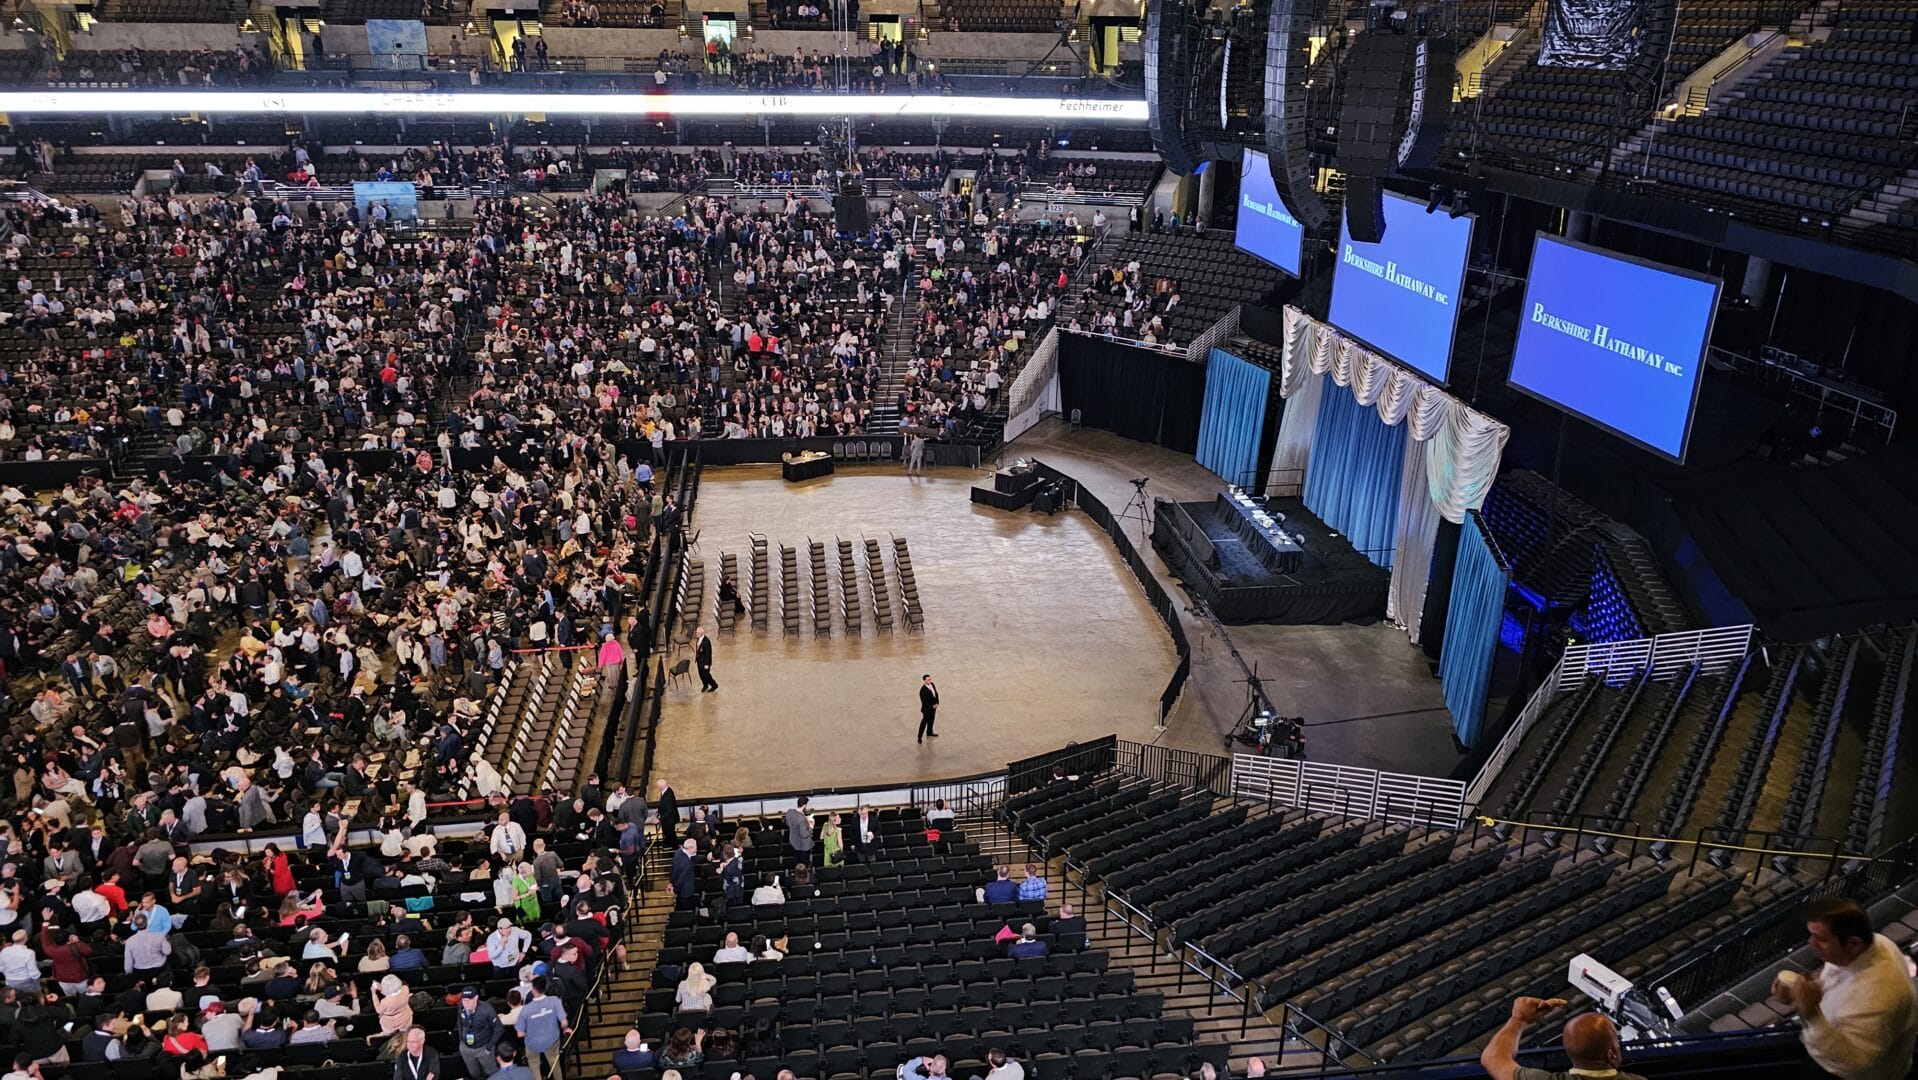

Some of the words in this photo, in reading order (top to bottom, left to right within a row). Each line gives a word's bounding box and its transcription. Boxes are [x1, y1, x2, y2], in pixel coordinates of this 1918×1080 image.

[1060, 99, 1124, 112] Fechheimer
[1343, 244, 1385, 278] BERKSHIRE
[1385, 260, 1436, 299] HATHAWAY
[1531, 302, 1591, 342] BERKSHIRE
[1592, 324, 1665, 369] HATHAWAY
[1664, 361, 1683, 377] INC.
